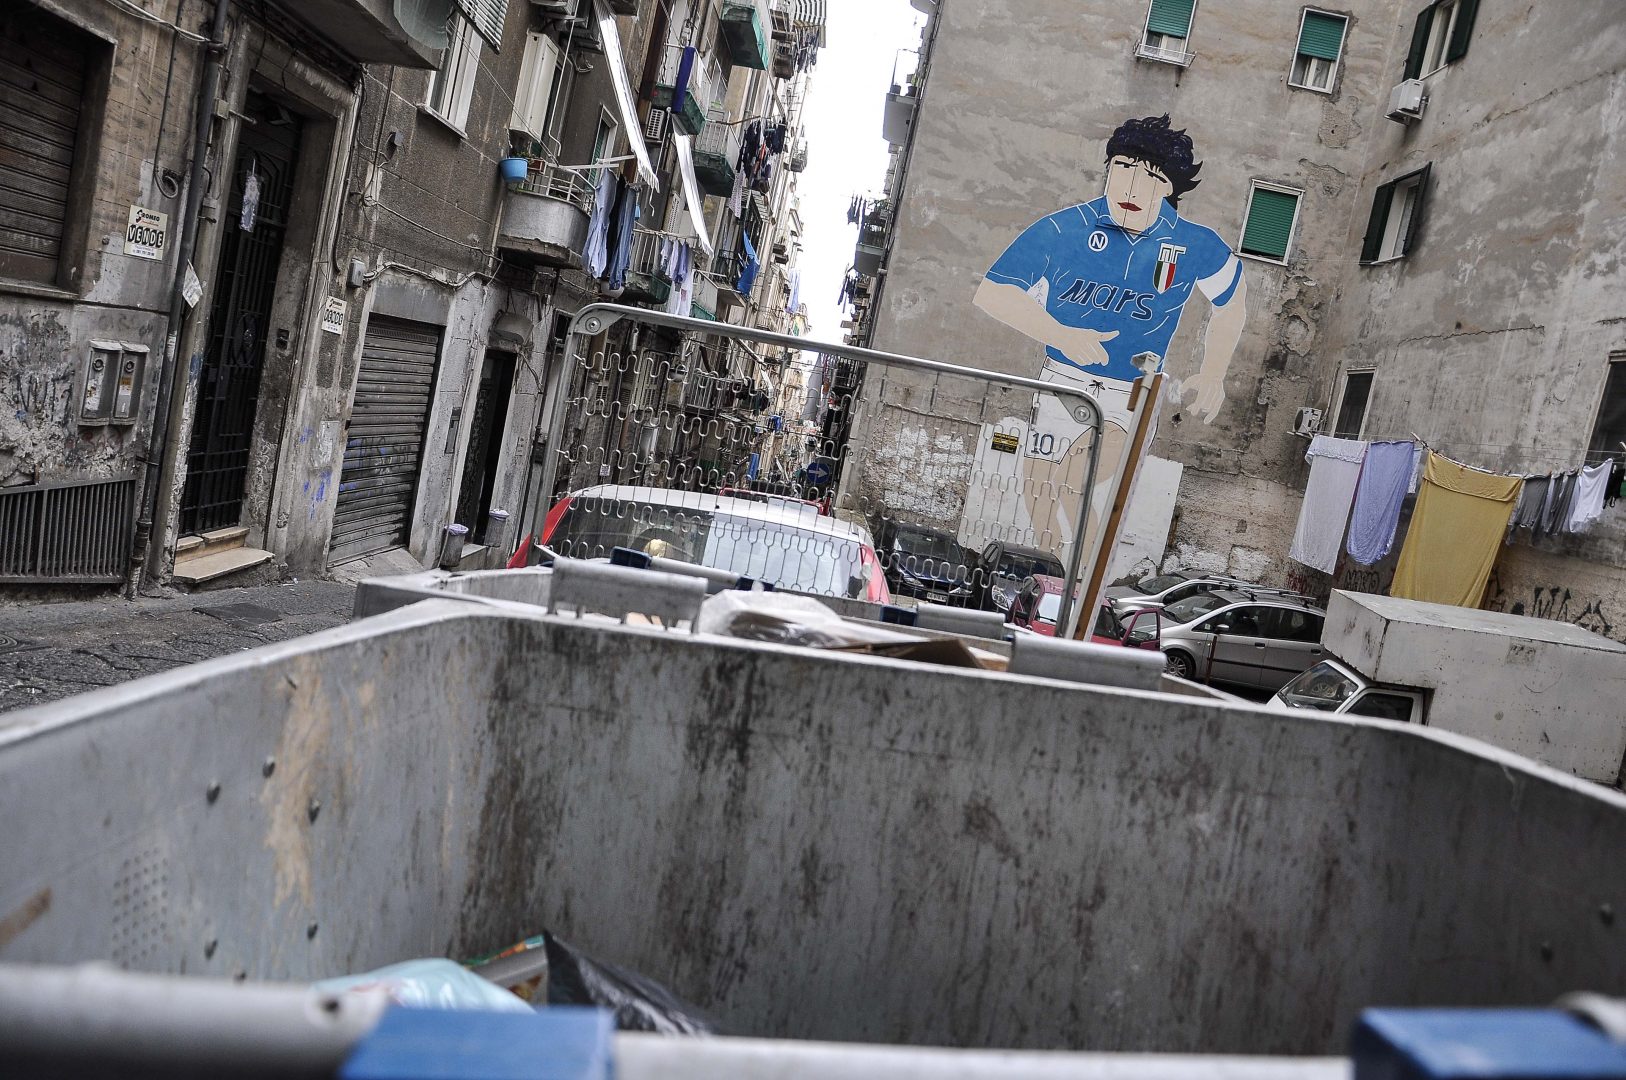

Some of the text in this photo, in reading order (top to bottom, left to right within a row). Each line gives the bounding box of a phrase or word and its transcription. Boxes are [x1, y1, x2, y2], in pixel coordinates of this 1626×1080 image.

[128, 225, 164, 248] VENDE
[1090, 233, 1106, 250] N
[1057, 279, 1155, 321] Mars
[1031, 432, 1055, 456] 10
